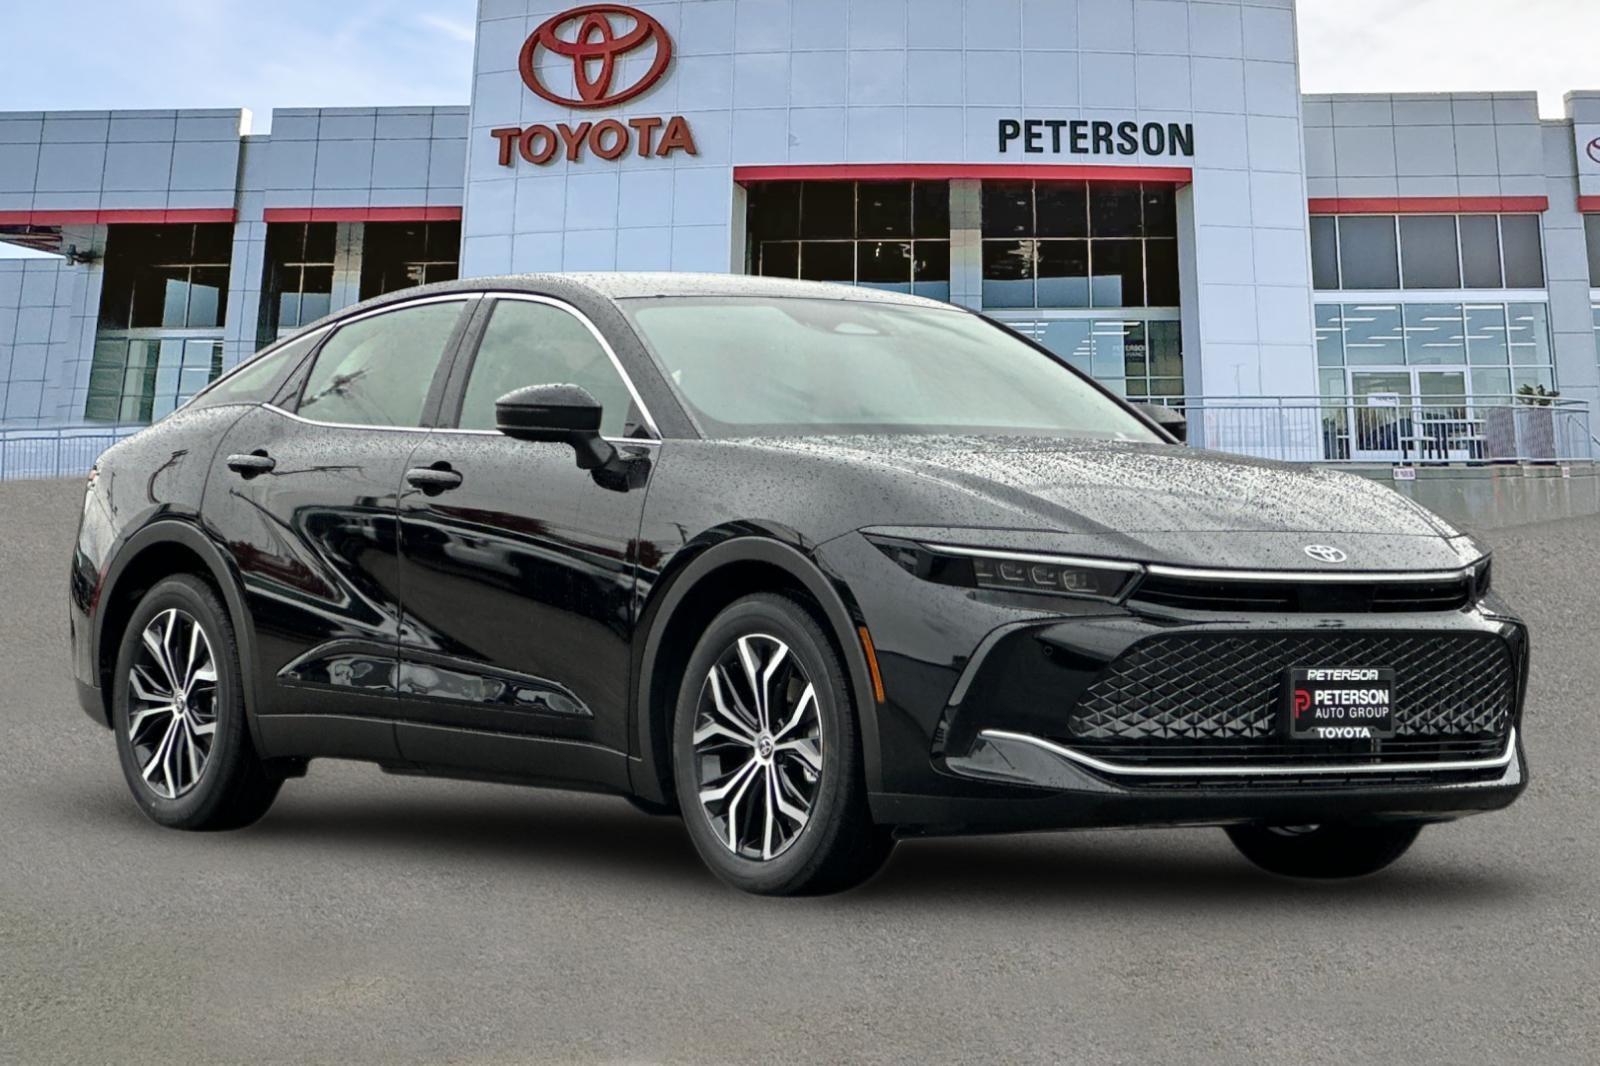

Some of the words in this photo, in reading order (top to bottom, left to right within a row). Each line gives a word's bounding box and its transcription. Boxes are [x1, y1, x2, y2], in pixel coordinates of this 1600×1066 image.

[491, 116, 698, 166] TOYOTA
[998, 119, 1195, 156] PETERSON
[1314, 689, 1389, 705] PETERSON
[1315, 707, 1344, 718] AUTO
[1349, 707, 1389, 718] GROUP
[1317, 727, 1371, 738] TOYOTA
